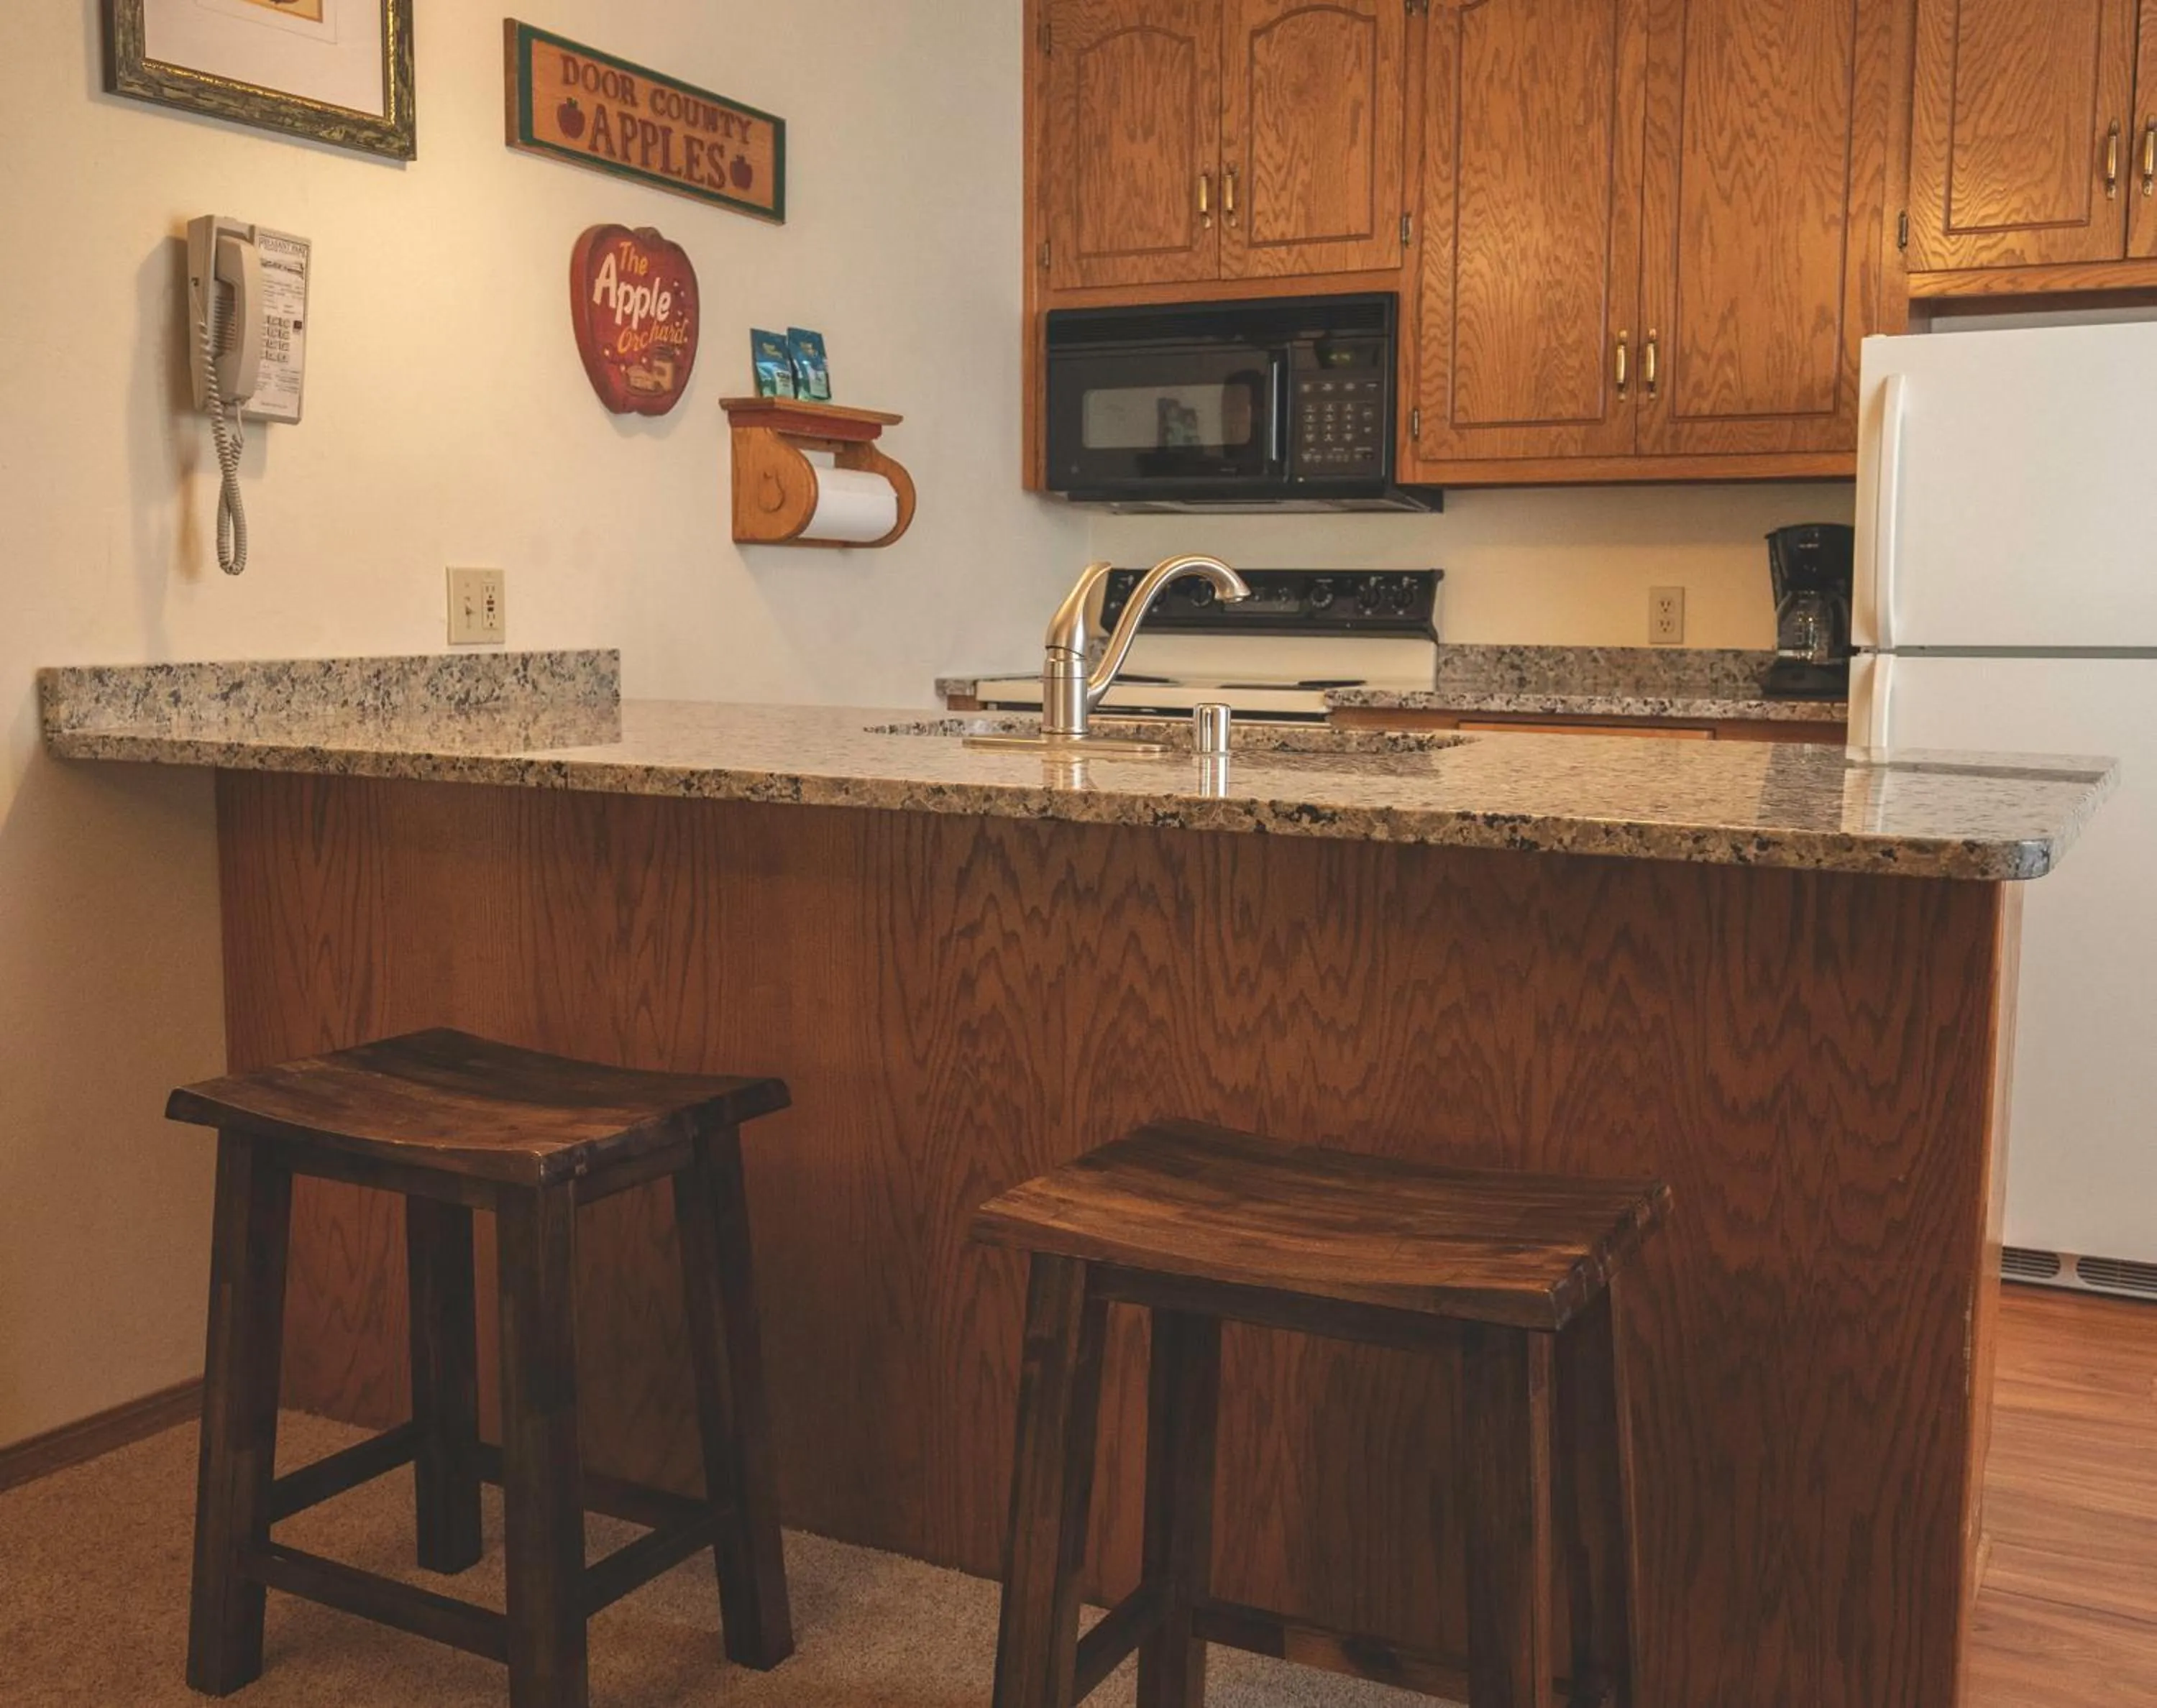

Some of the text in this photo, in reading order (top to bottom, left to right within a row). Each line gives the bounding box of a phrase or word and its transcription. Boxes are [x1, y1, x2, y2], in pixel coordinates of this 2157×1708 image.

[559, 52, 753, 145] DOOR COUNTY
[588, 103, 726, 190] APPLES
[592, 252, 672, 330] Apple
[619, 241, 649, 276] The
